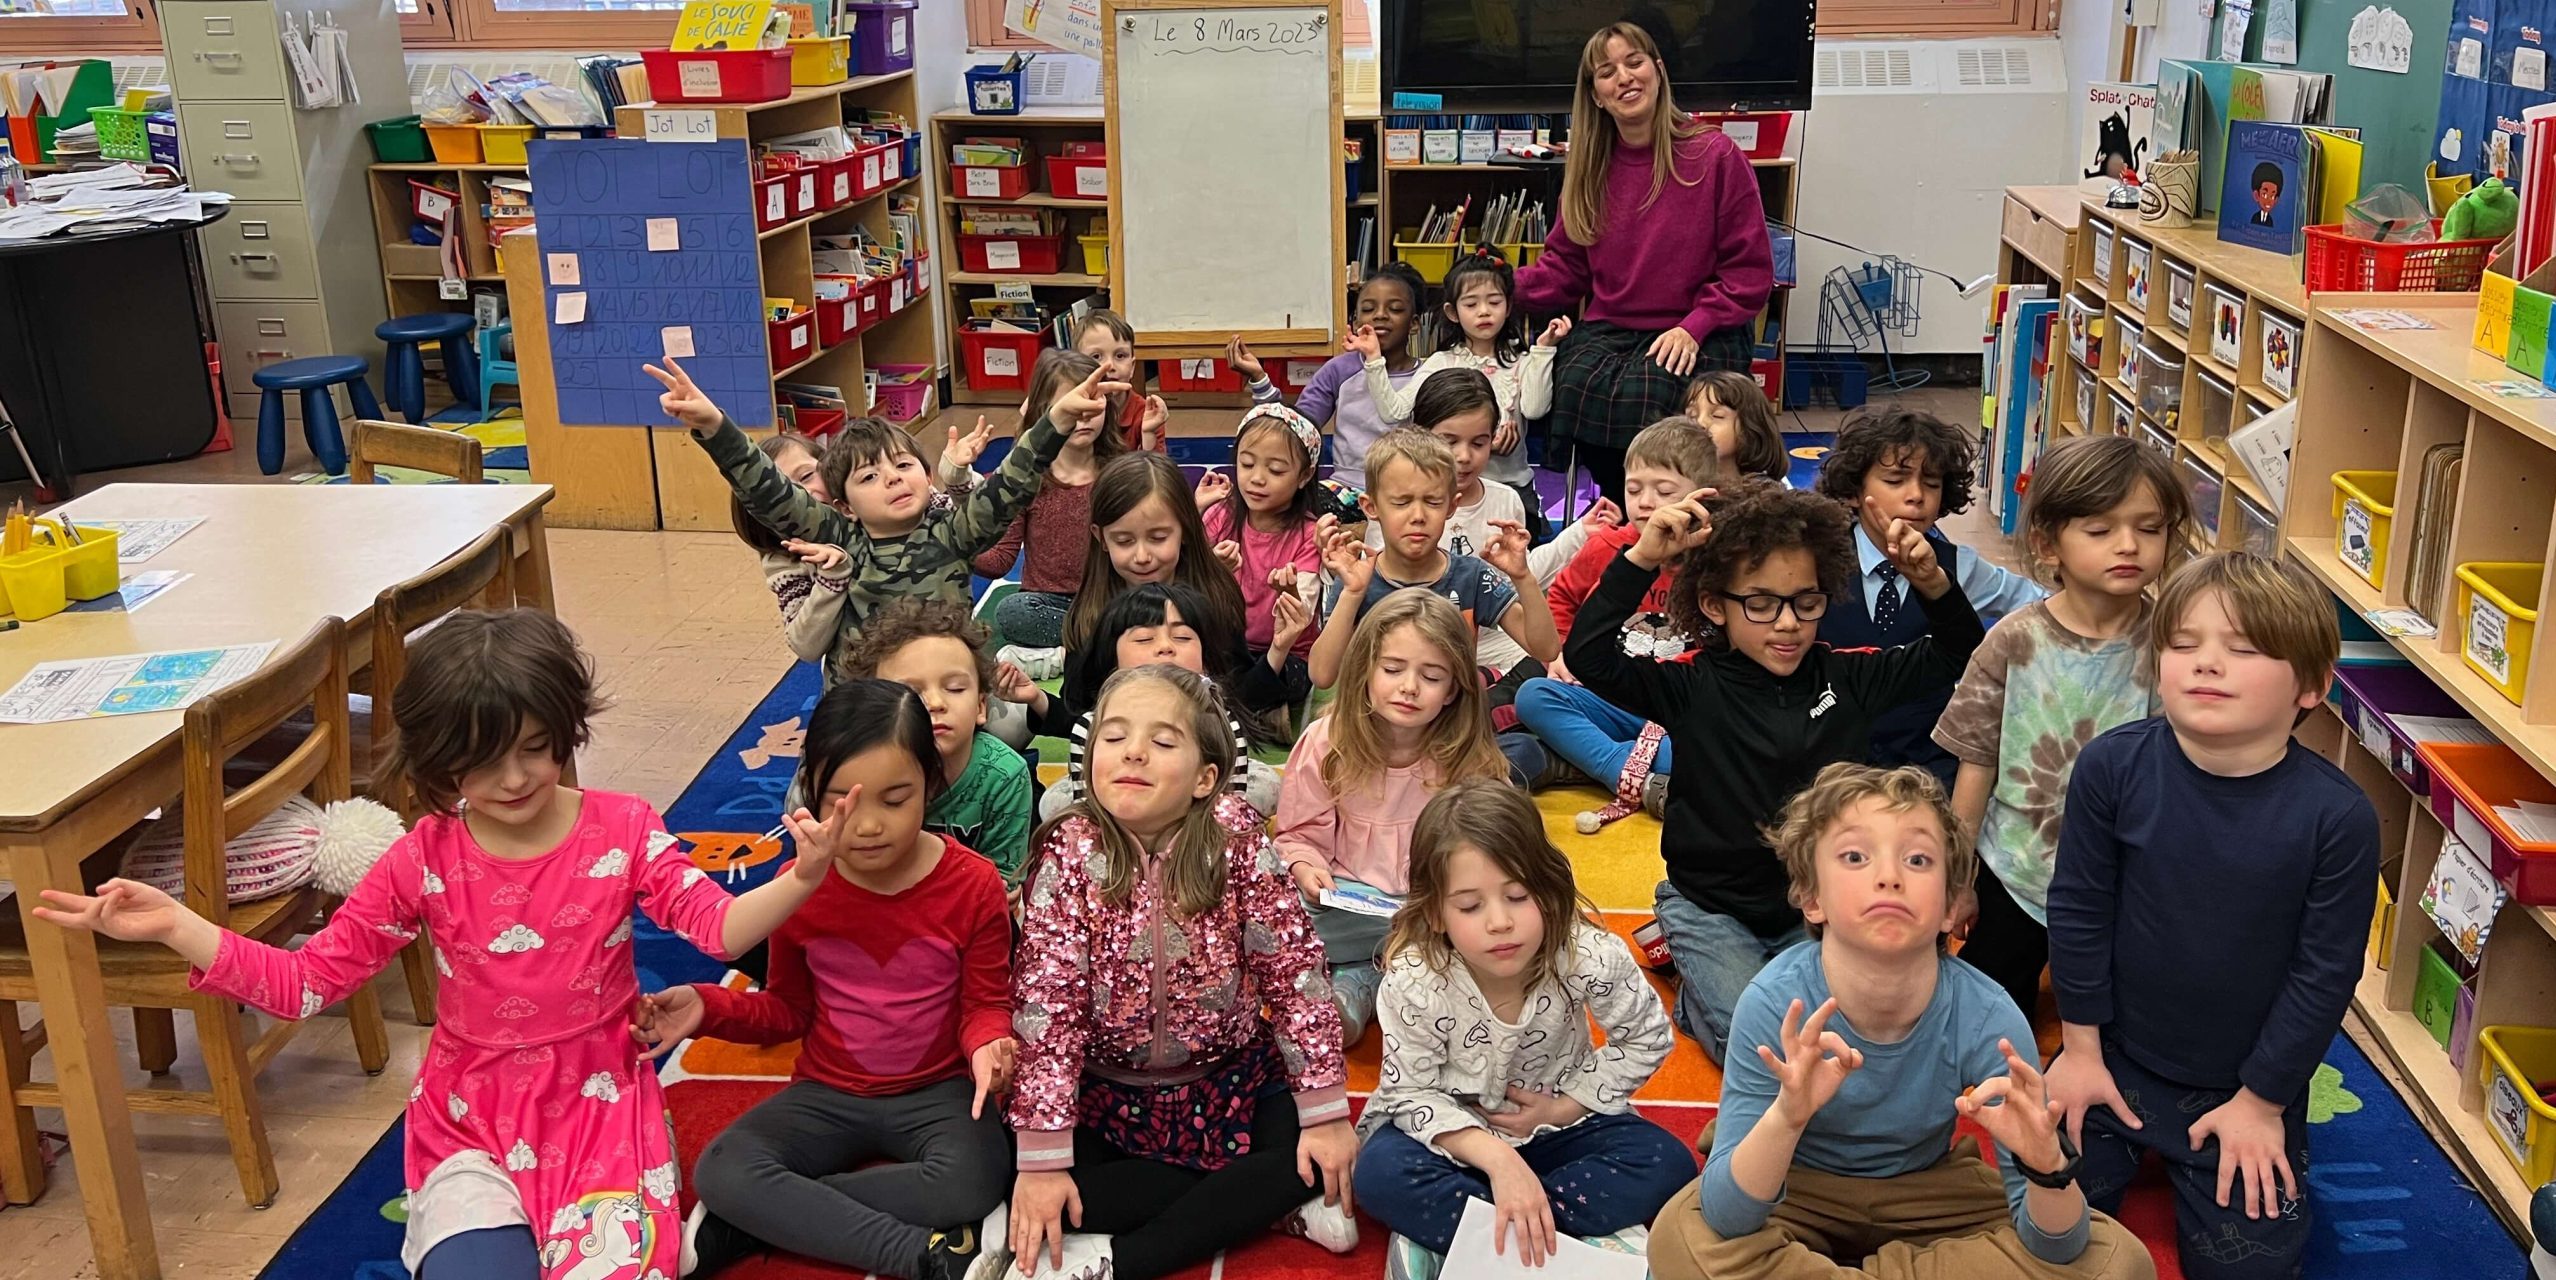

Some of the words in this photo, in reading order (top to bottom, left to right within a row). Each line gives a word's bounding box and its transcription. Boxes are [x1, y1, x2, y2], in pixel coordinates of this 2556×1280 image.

[694, 8, 708, 18] LE
[711, 2, 756, 20] SOUCI
[1067, 11, 1089, 28] dans
[687, 26, 701, 37] DE
[704, 20, 752, 39] CALIE
[1064, 29, 1080, 41] une
[1154, 19, 1177, 42] Le
[1194, 17, 1205, 41] 8
[1217, 18, 1260, 42] Mars
[1267, 22, 1318, 43] 2023
[2090, 88, 2121, 105] Splat
[2128, 92, 2156, 109] Chat
[650, 115, 674, 133] Jot
[686, 114, 711, 133] Lot
[2269, 130, 2301, 156] AFR
[543, 146, 637, 206] JOT
[657, 149, 738, 199] LOT
[427, 195, 435, 208] B
[771, 194, 778, 215] A
[801, 184, 808, 199] A
[550, 217, 571, 247] 1
[585, 216, 609, 247] 2
[618, 216, 643, 247] 3
[685, 216, 705, 247] 5
[727, 215, 744, 247] 6
[594, 253, 606, 282] 8
[627, 251, 640, 283] 9
[654, 256, 684, 283] 10
[686, 256, 716, 284] 11
[725, 253, 755, 284] 12
[626, 291, 649, 319] 15
[657, 290, 684, 320] 16
[689, 291, 721, 318] 17
[725, 291, 752, 321] 18
[1000, 289, 1029, 299] Fiction
[553, 325, 584, 356] 19
[598, 327, 625, 356] 20
[732, 328, 760, 356] 24
[2480, 319, 2494, 349] A
[986, 356, 1015, 367] Fiction
[2514, 333, 2530, 367] A
[561, 359, 598, 387] 25
[1810, 694, 1837, 719] PUMA
[2452, 849, 2467, 869] Papier
[2466, 866, 2490, 894] d'écriture
[2425, 999, 2432, 1026] B
[2499, 1079, 2524, 1116] ciseaux
